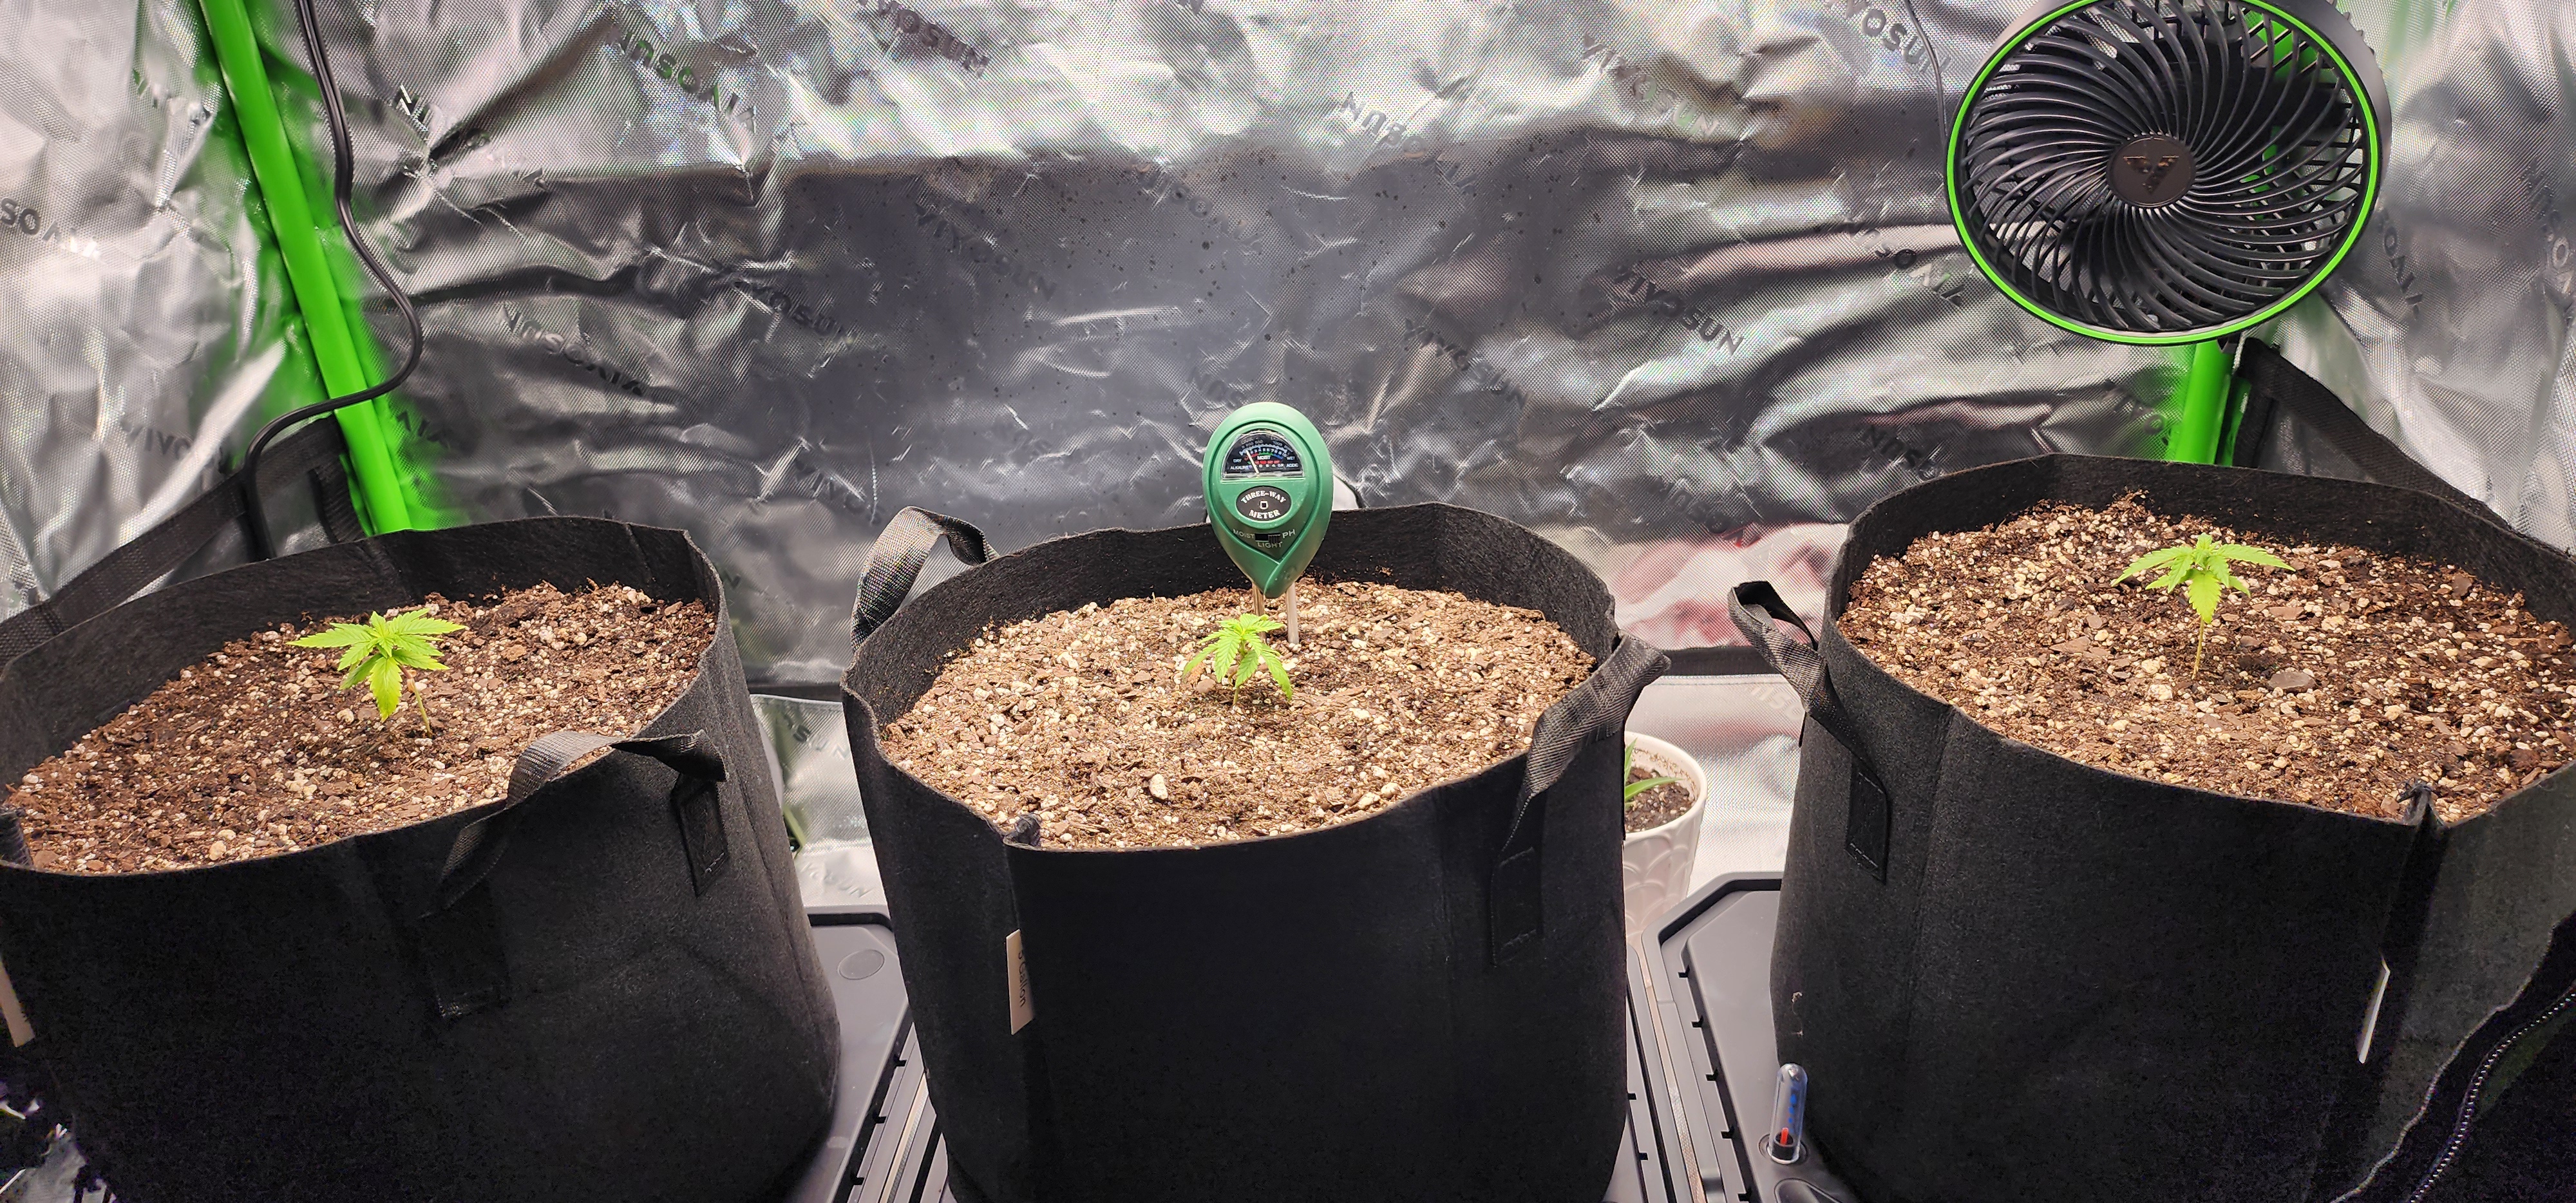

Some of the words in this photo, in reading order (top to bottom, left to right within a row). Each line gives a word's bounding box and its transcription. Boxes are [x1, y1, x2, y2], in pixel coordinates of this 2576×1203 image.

[858, 0, 990, 79] VOSUN
[1826, 0, 1952, 74] VOSUN
[1581, 33, 1719, 138] VIVOSUN
[1613, 263, 1745, 355] VIVOSUN
[1240, 490, 1287, 504] THREE-WAY
[1249, 509, 1281, 519] METER
[1233, 528, 1255, 539] MOIST
[1282, 528, 1296, 539] PH
[1019, 961, 1028, 1008] Gallon
